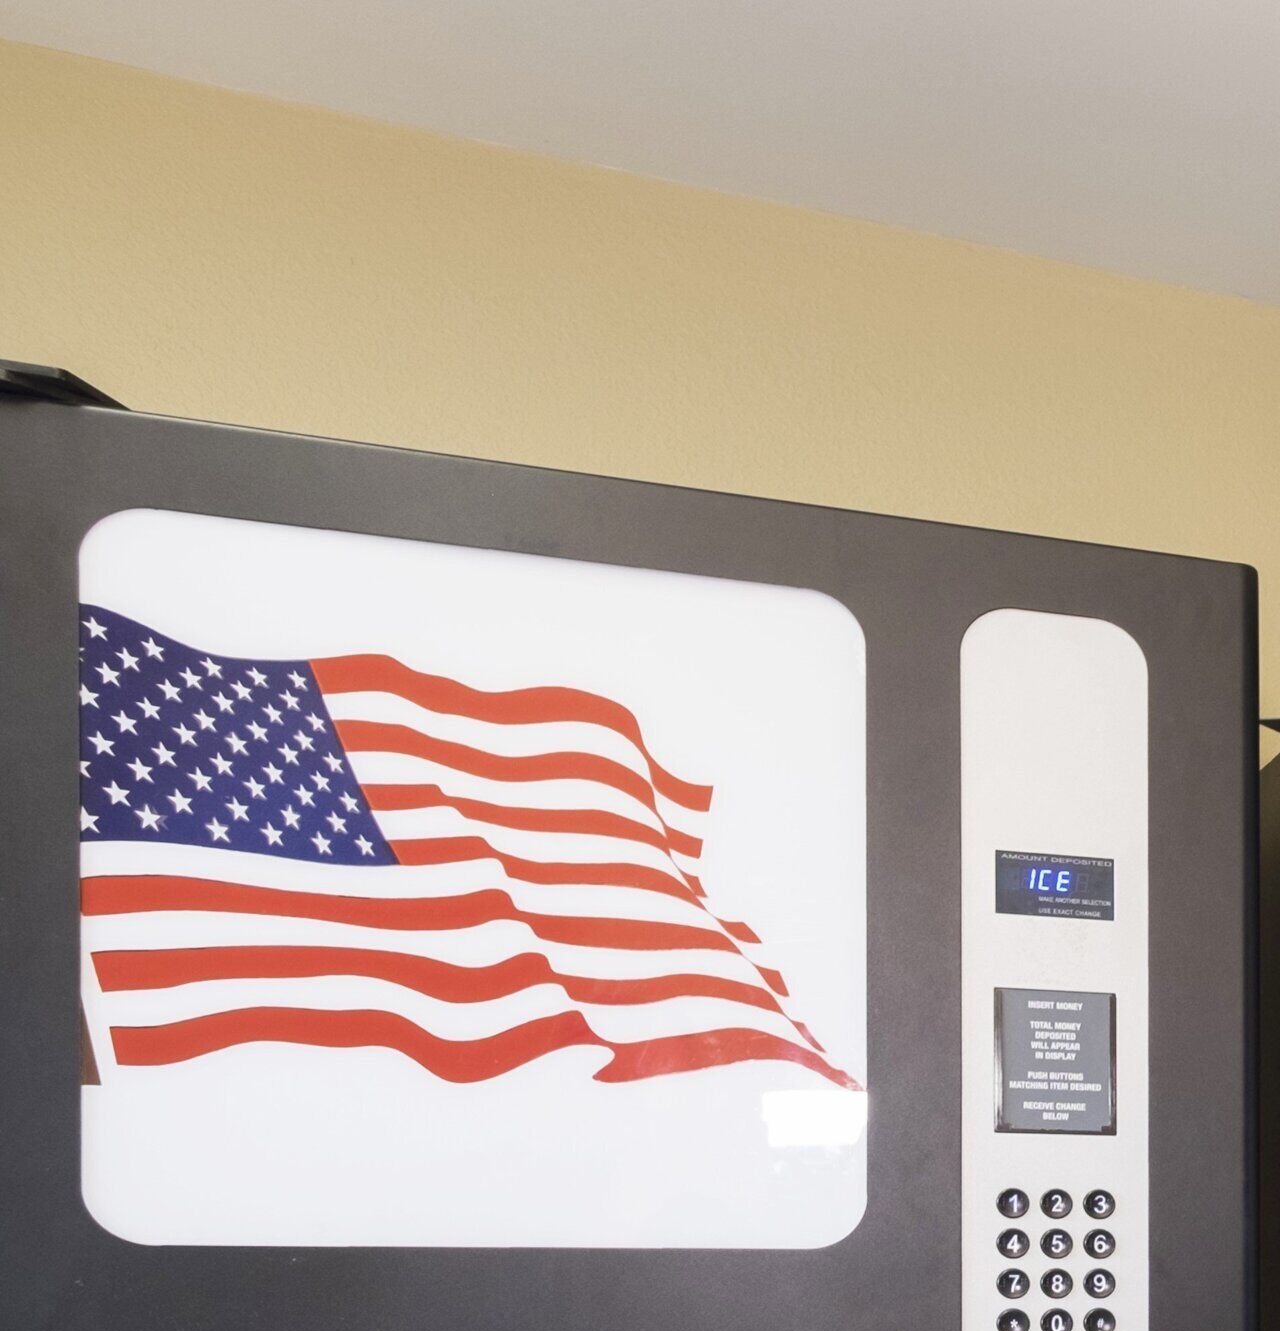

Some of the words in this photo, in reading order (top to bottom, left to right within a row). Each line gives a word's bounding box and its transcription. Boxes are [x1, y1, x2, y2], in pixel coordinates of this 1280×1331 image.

[1001, 852, 1048, 863] AMOUNT
[1050, 857, 1112, 867] DEPOSITED
[1029, 869, 1070, 892] ICE
[1075, 909, 1101, 918] CHANGE
[1027, 1000, 1054, 1010] INSERT
[1055, 1002, 1083, 1011] MONEY
[1030, 1021, 1053, 1030] TOTAL
[1054, 1022, 1081, 1031] MONEY
[1034, 1031, 1077, 1041] DEPOSITED
[1030, 1041, 1049, 1050] WILL
[1050, 1042, 1080, 1051] APPEAR
[1035, 1051, 1044, 1060] IN
[1045, 1052, 1077, 1061] DISPLAY
[1027, 1071, 1048, 1080] PUSH
[1049, 1071, 1084, 1081] BUTTONS
[1009, 1081, 1048, 1090] MATCHING
[1050, 1082, 1069, 1091] ITEM
[1069, 1082, 1102, 1092] DESIRED
[1023, 1101, 1055, 1111] RECEIVE
[1055, 1102, 1086, 1111] CHANGE
[1042, 1111, 1069, 1121] BELOW
[1010, 1194, 1019, 1213] 1
[1051, 1194, 1063, 1213] 2
[1094, 1195, 1107, 1214] 3
[1007, 1234, 1020, 1253] 4
[1052, 1234, 1064, 1253] 5
[1094, 1235, 1106, 1254] 6
[1008, 1274, 1020, 1293] 7
[1051, 1275, 1063, 1293] 8
[1093, 1275, 1106, 1293] 9
